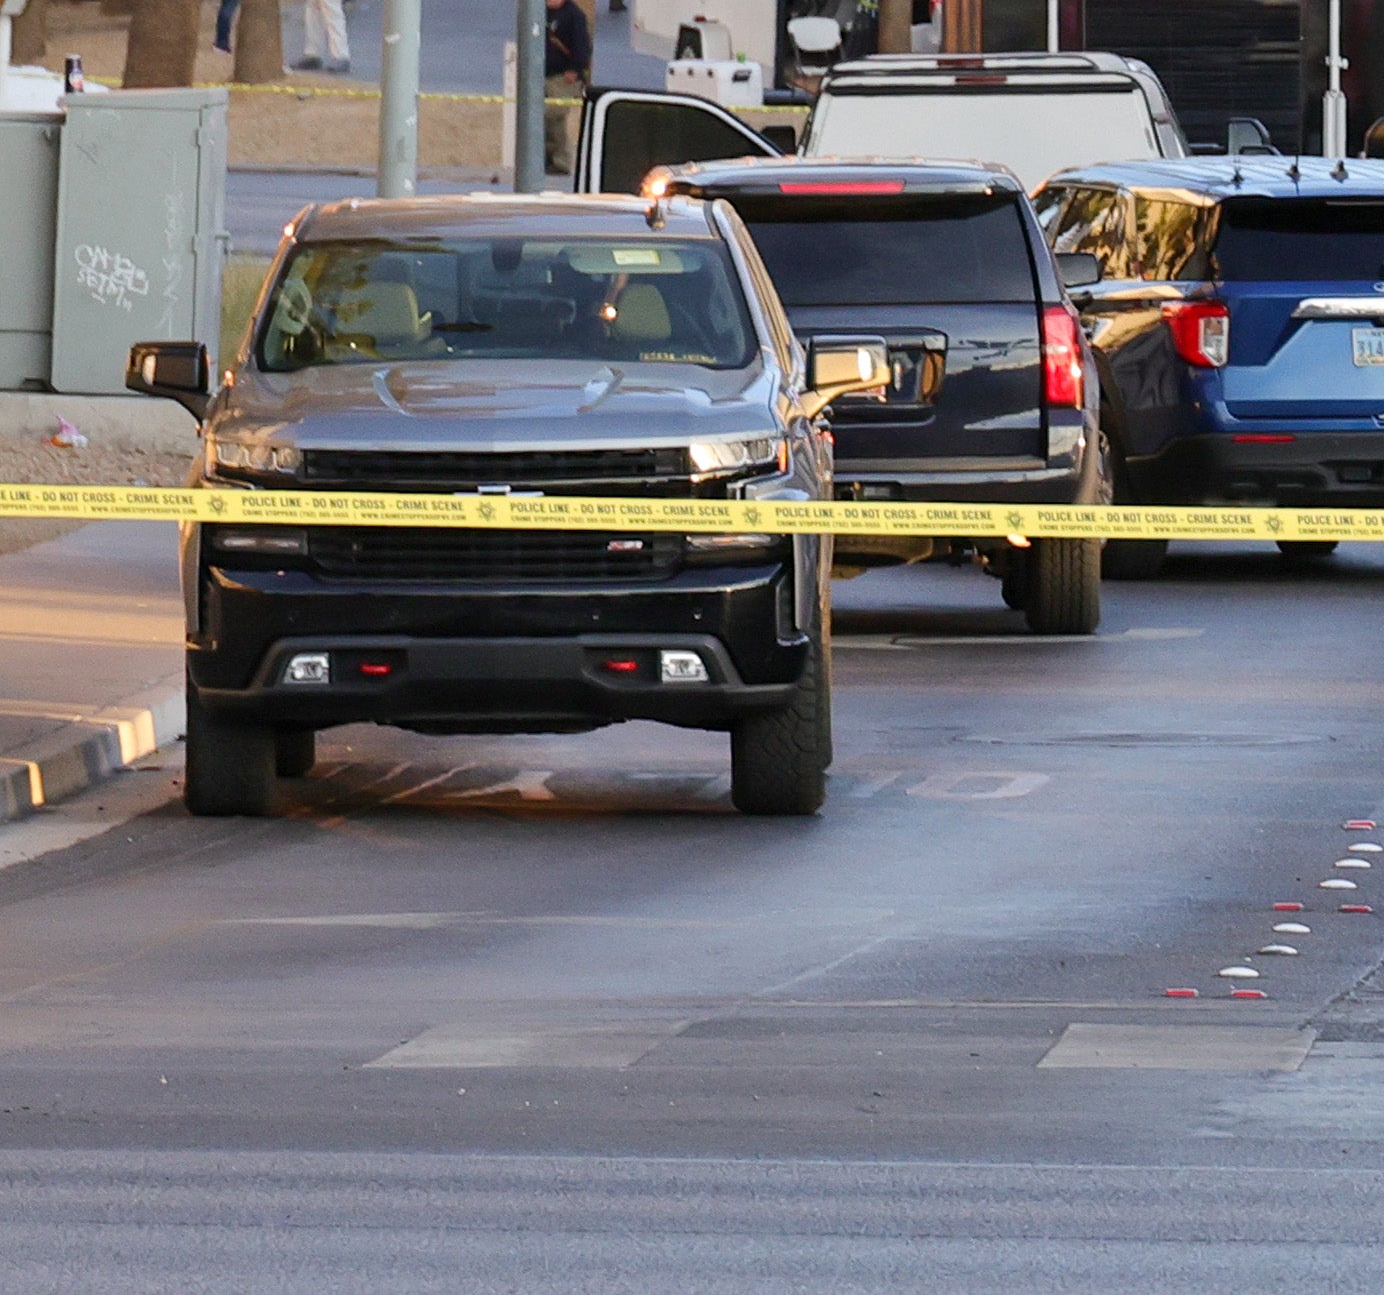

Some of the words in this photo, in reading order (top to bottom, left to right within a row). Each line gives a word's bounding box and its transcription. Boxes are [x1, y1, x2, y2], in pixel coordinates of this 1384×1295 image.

[10, 490, 31, 501] LINE
[43, 491, 56, 501] DO
[60, 491, 78, 502] NOT
[82, 492, 116, 503] CROSS
[126, 493, 159, 504] CRIME
[163, 494, 194, 505] SCENE
[242, 496, 276, 507] POLICE
[280, 497, 301, 507] LINE
[312, 498, 326, 508] DO
[330, 498, 348, 508] NOT
[352, 499, 386, 509] CROSS
[396, 500, 427, 510] CRIME
[431, 501, 463, 511] SCENE
[510, 502, 545, 513] POLICE
[549, 503, 570, 513] LINE
[581, 504, 595, 514] DO
[598, 504, 615, 514] NOT
[620, 504, 653, 515] CROSS
[663, 505, 694, 515] CRIME
[698, 506, 729, 516] SCENE
[775, 507, 809, 517] POLICE
[813, 508, 834, 518] LINE
[845, 508, 859, 518] DO
[863, 509, 880, 519] NOT
[884, 509, 918, 519] CROSS
[927, 510, 958, 520] CRIME
[962, 510, 992, 520] SCENE
[1038, 511, 1072, 521] POLICE
[1076, 512, 1096, 522] LINE
[1107, 512, 1120, 522] DO
[1124, 512, 1141, 522] NOT
[1145, 513, 1177, 523] CROSS
[1187, 513, 1217, 523] CRIME
[1221, 514, 1252, 524] SCENE
[1297, 515, 1330, 525] POLICE
[1334, 515, 1354, 525] LINE
[1365, 515, 1378, 525] DO
